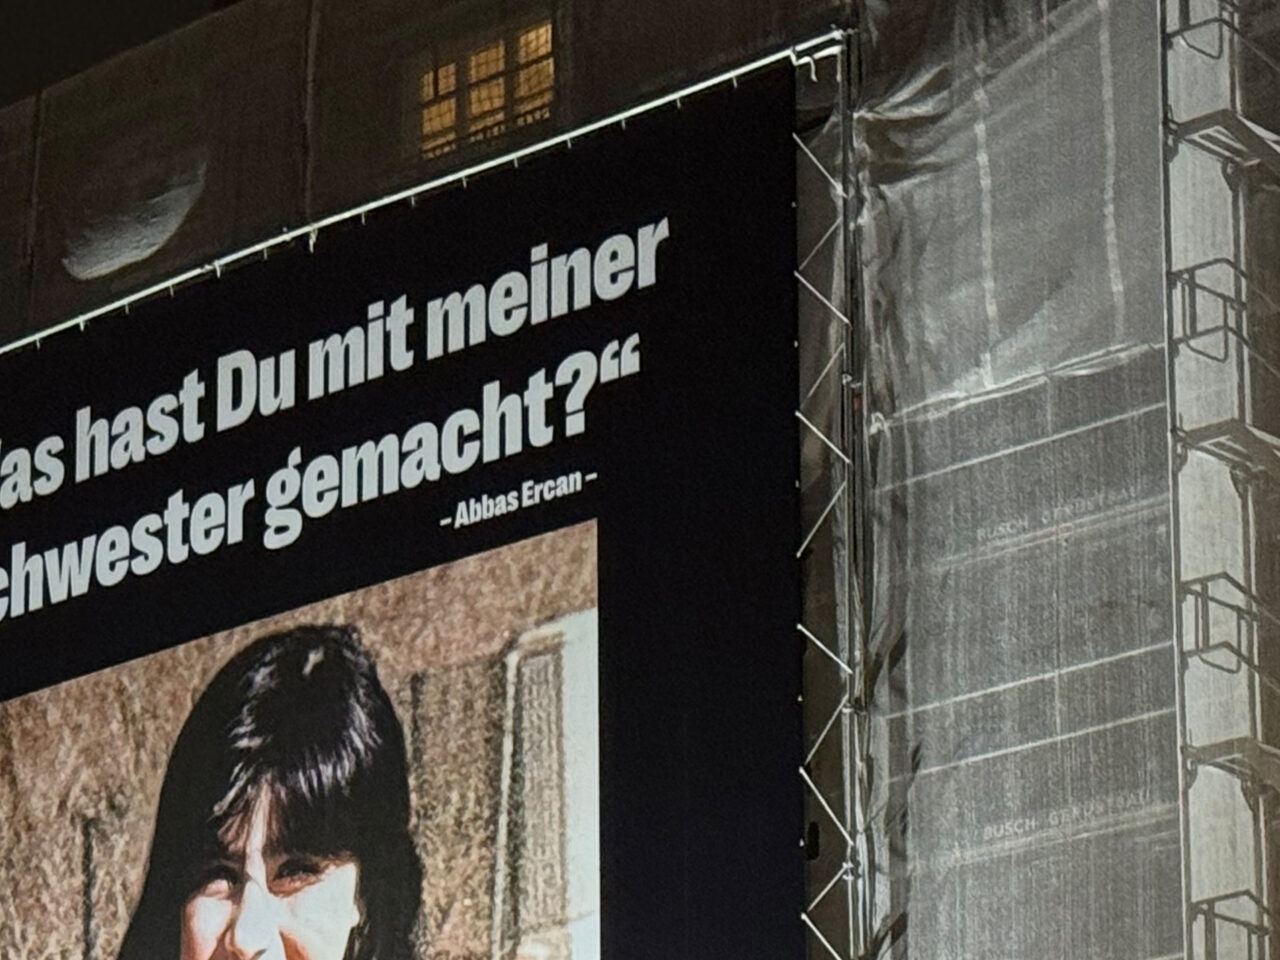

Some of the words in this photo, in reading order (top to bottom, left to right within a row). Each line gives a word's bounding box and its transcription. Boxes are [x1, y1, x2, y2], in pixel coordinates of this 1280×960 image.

[75, 368, 206, 484] hast
[217, 349, 296, 432] Du
[308, 294, 415, 400] mit
[427, 216, 670, 360] meiner
[454, 490, 519, 529] Abbas
[522, 470, 582, 508] Ercan
